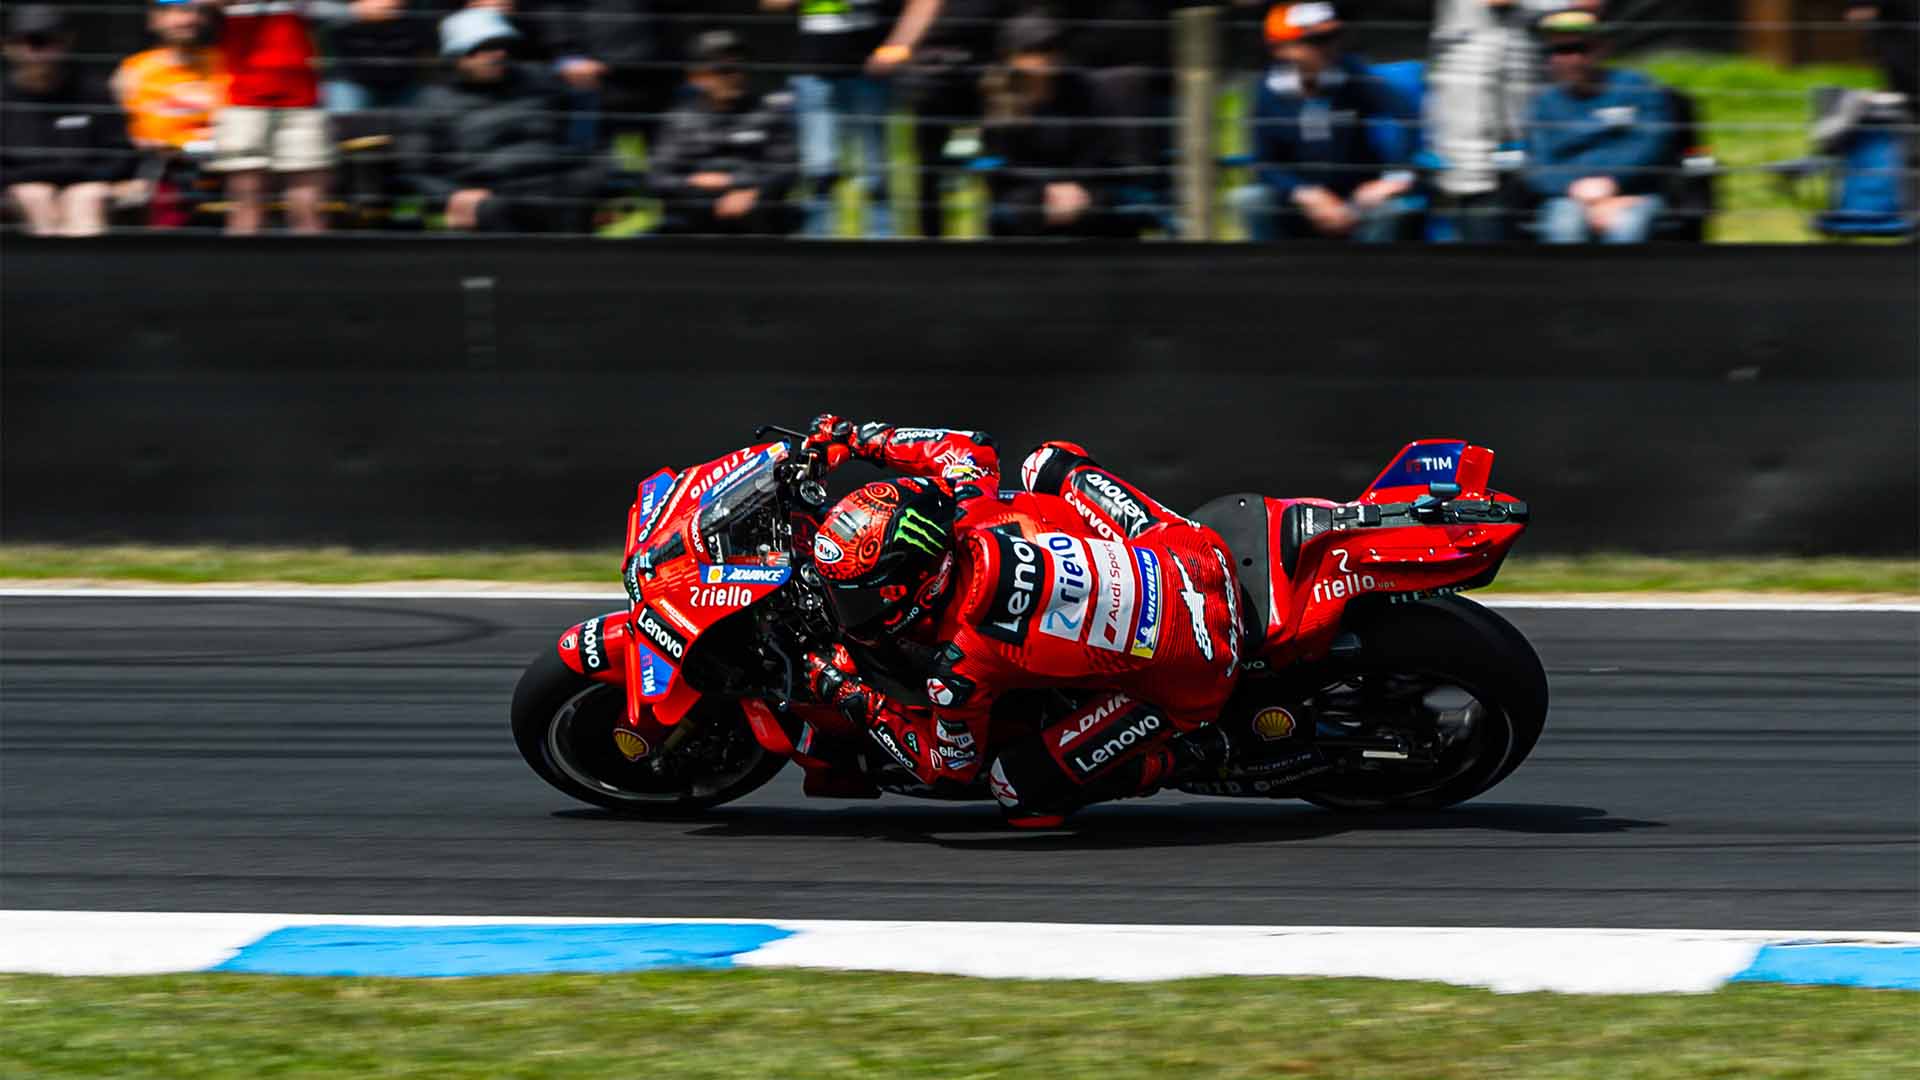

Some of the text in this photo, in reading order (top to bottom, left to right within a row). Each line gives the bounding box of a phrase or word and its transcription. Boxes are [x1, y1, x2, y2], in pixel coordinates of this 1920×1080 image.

[1424, 456, 1452, 470] TIM
[1086, 472, 1149, 526] Lenovo
[727, 567, 782, 582] ADVANCE
[992, 529, 1036, 633] Leno
[1313, 573, 1375, 603] riello
[701, 586, 752, 606] riello
[1109, 581, 1121, 622] Audi
[584, 617, 600, 668] enovo
[637, 607, 683, 658] Lenovo
[642, 666, 655, 692] TIM
[877, 726, 914, 769] Lenovo
[1075, 715, 1160, 773] Lenovo
